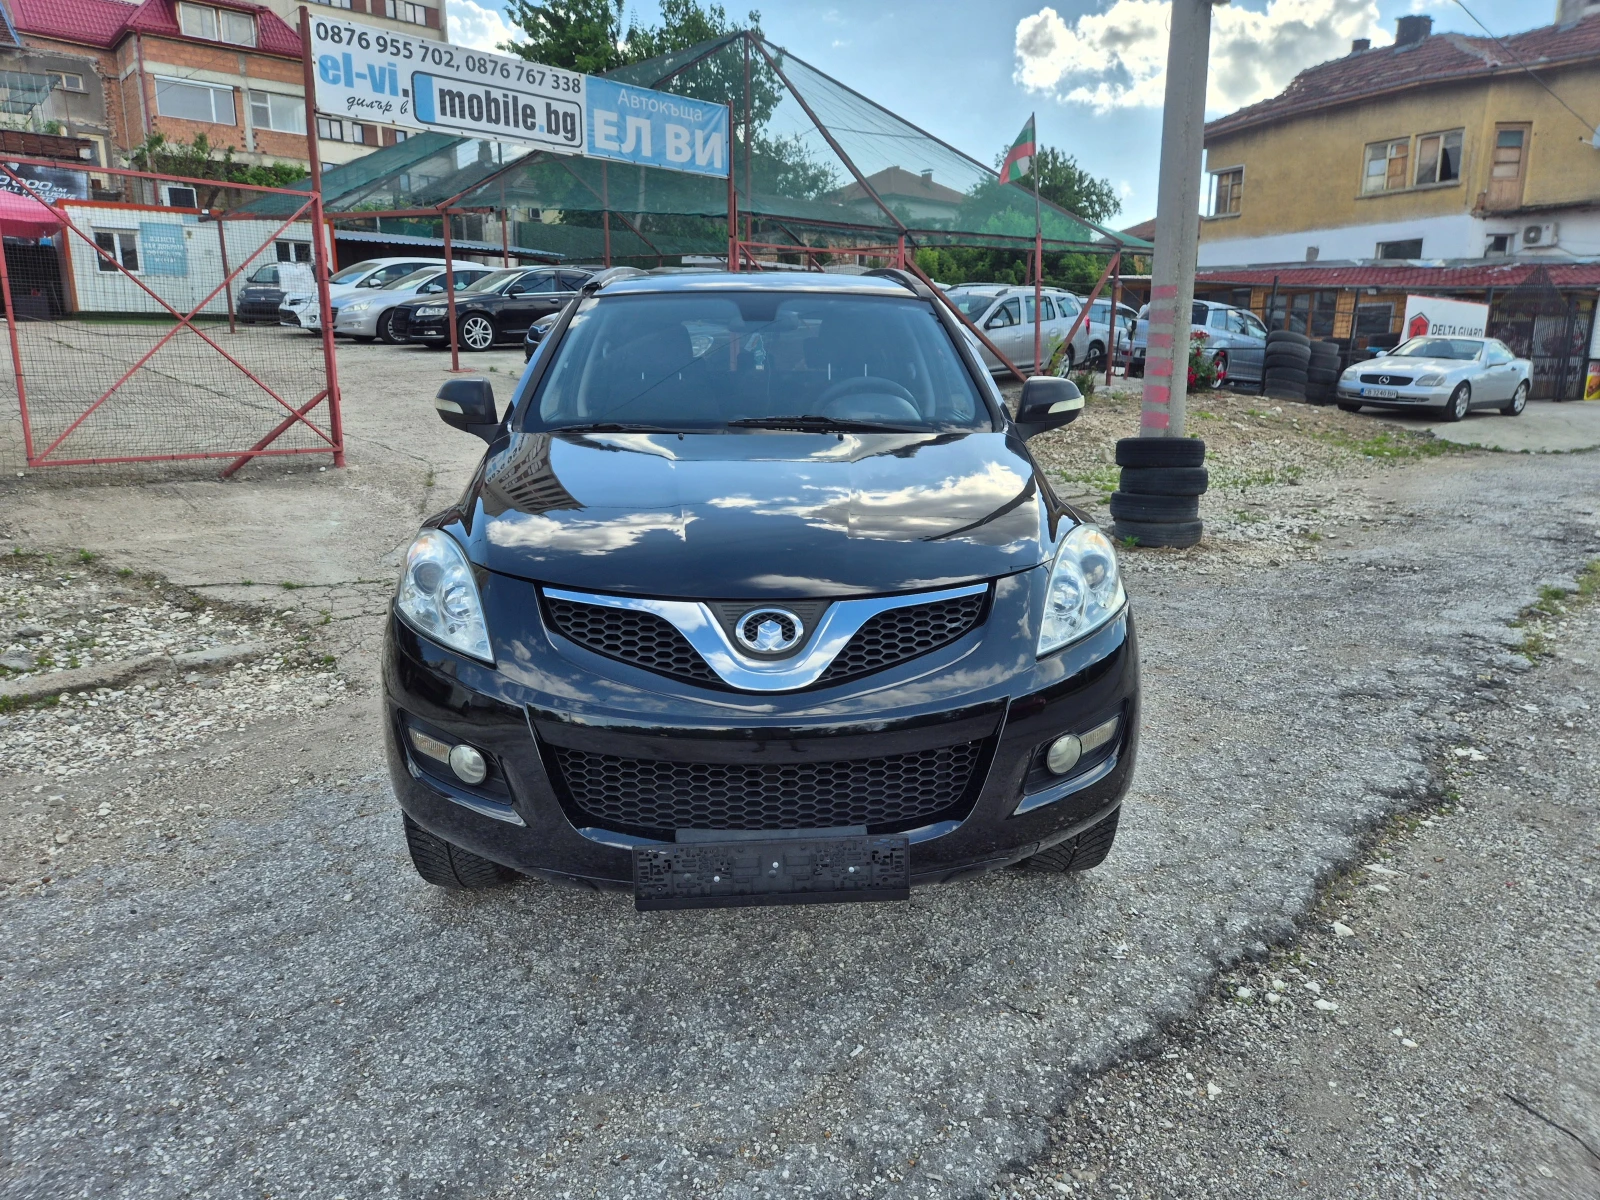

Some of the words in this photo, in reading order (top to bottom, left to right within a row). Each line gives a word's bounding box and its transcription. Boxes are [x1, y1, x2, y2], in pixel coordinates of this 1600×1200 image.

[315, 22, 371, 50] 0876
[375, 35, 414, 60] 955
[418, 43, 461, 72] 702,
[465, 55, 511, 79] 0876
[514, 65, 546, 87] 767
[551, 74, 582, 94] 338
[346, 96, 394, 115] дилър
[438, 87, 577, 142] mobile.bg
[617, 88, 703, 123] Автокъща
[593, 108, 652, 158] ЕЛ
[665, 123, 722, 169] ВИ
[1431, 324, 1457, 336] DELTA
[1457, 326, 1483, 338] GUARD
